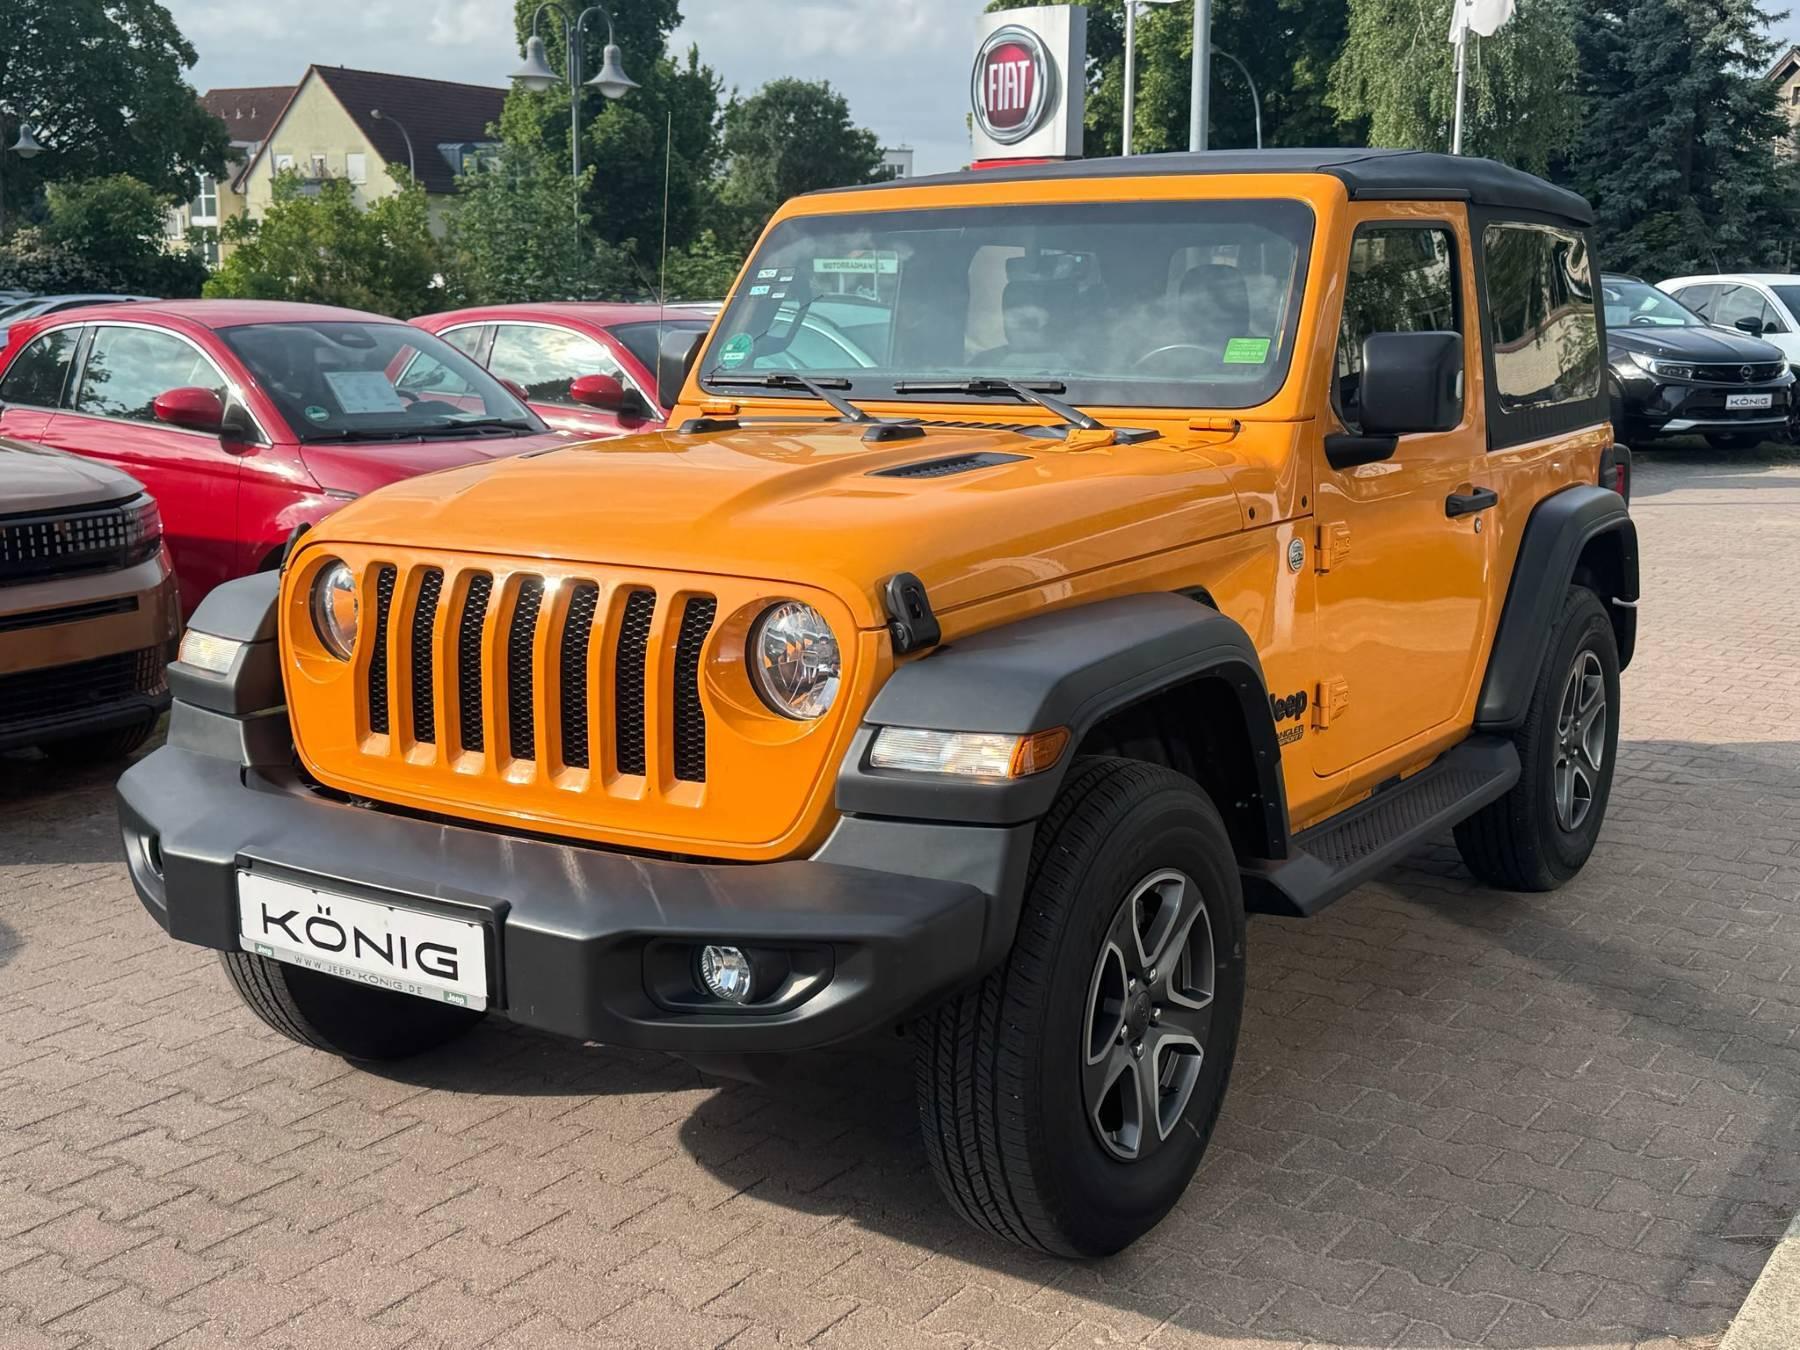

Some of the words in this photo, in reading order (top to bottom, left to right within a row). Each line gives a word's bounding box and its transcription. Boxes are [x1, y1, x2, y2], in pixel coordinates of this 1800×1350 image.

[988, 60, 1030, 112] FIAT
[1730, 396, 1769, 406] KÖNIG
[261, 902, 459, 981] KÖNIG
[447, 993, 465, 1006] Jeep
